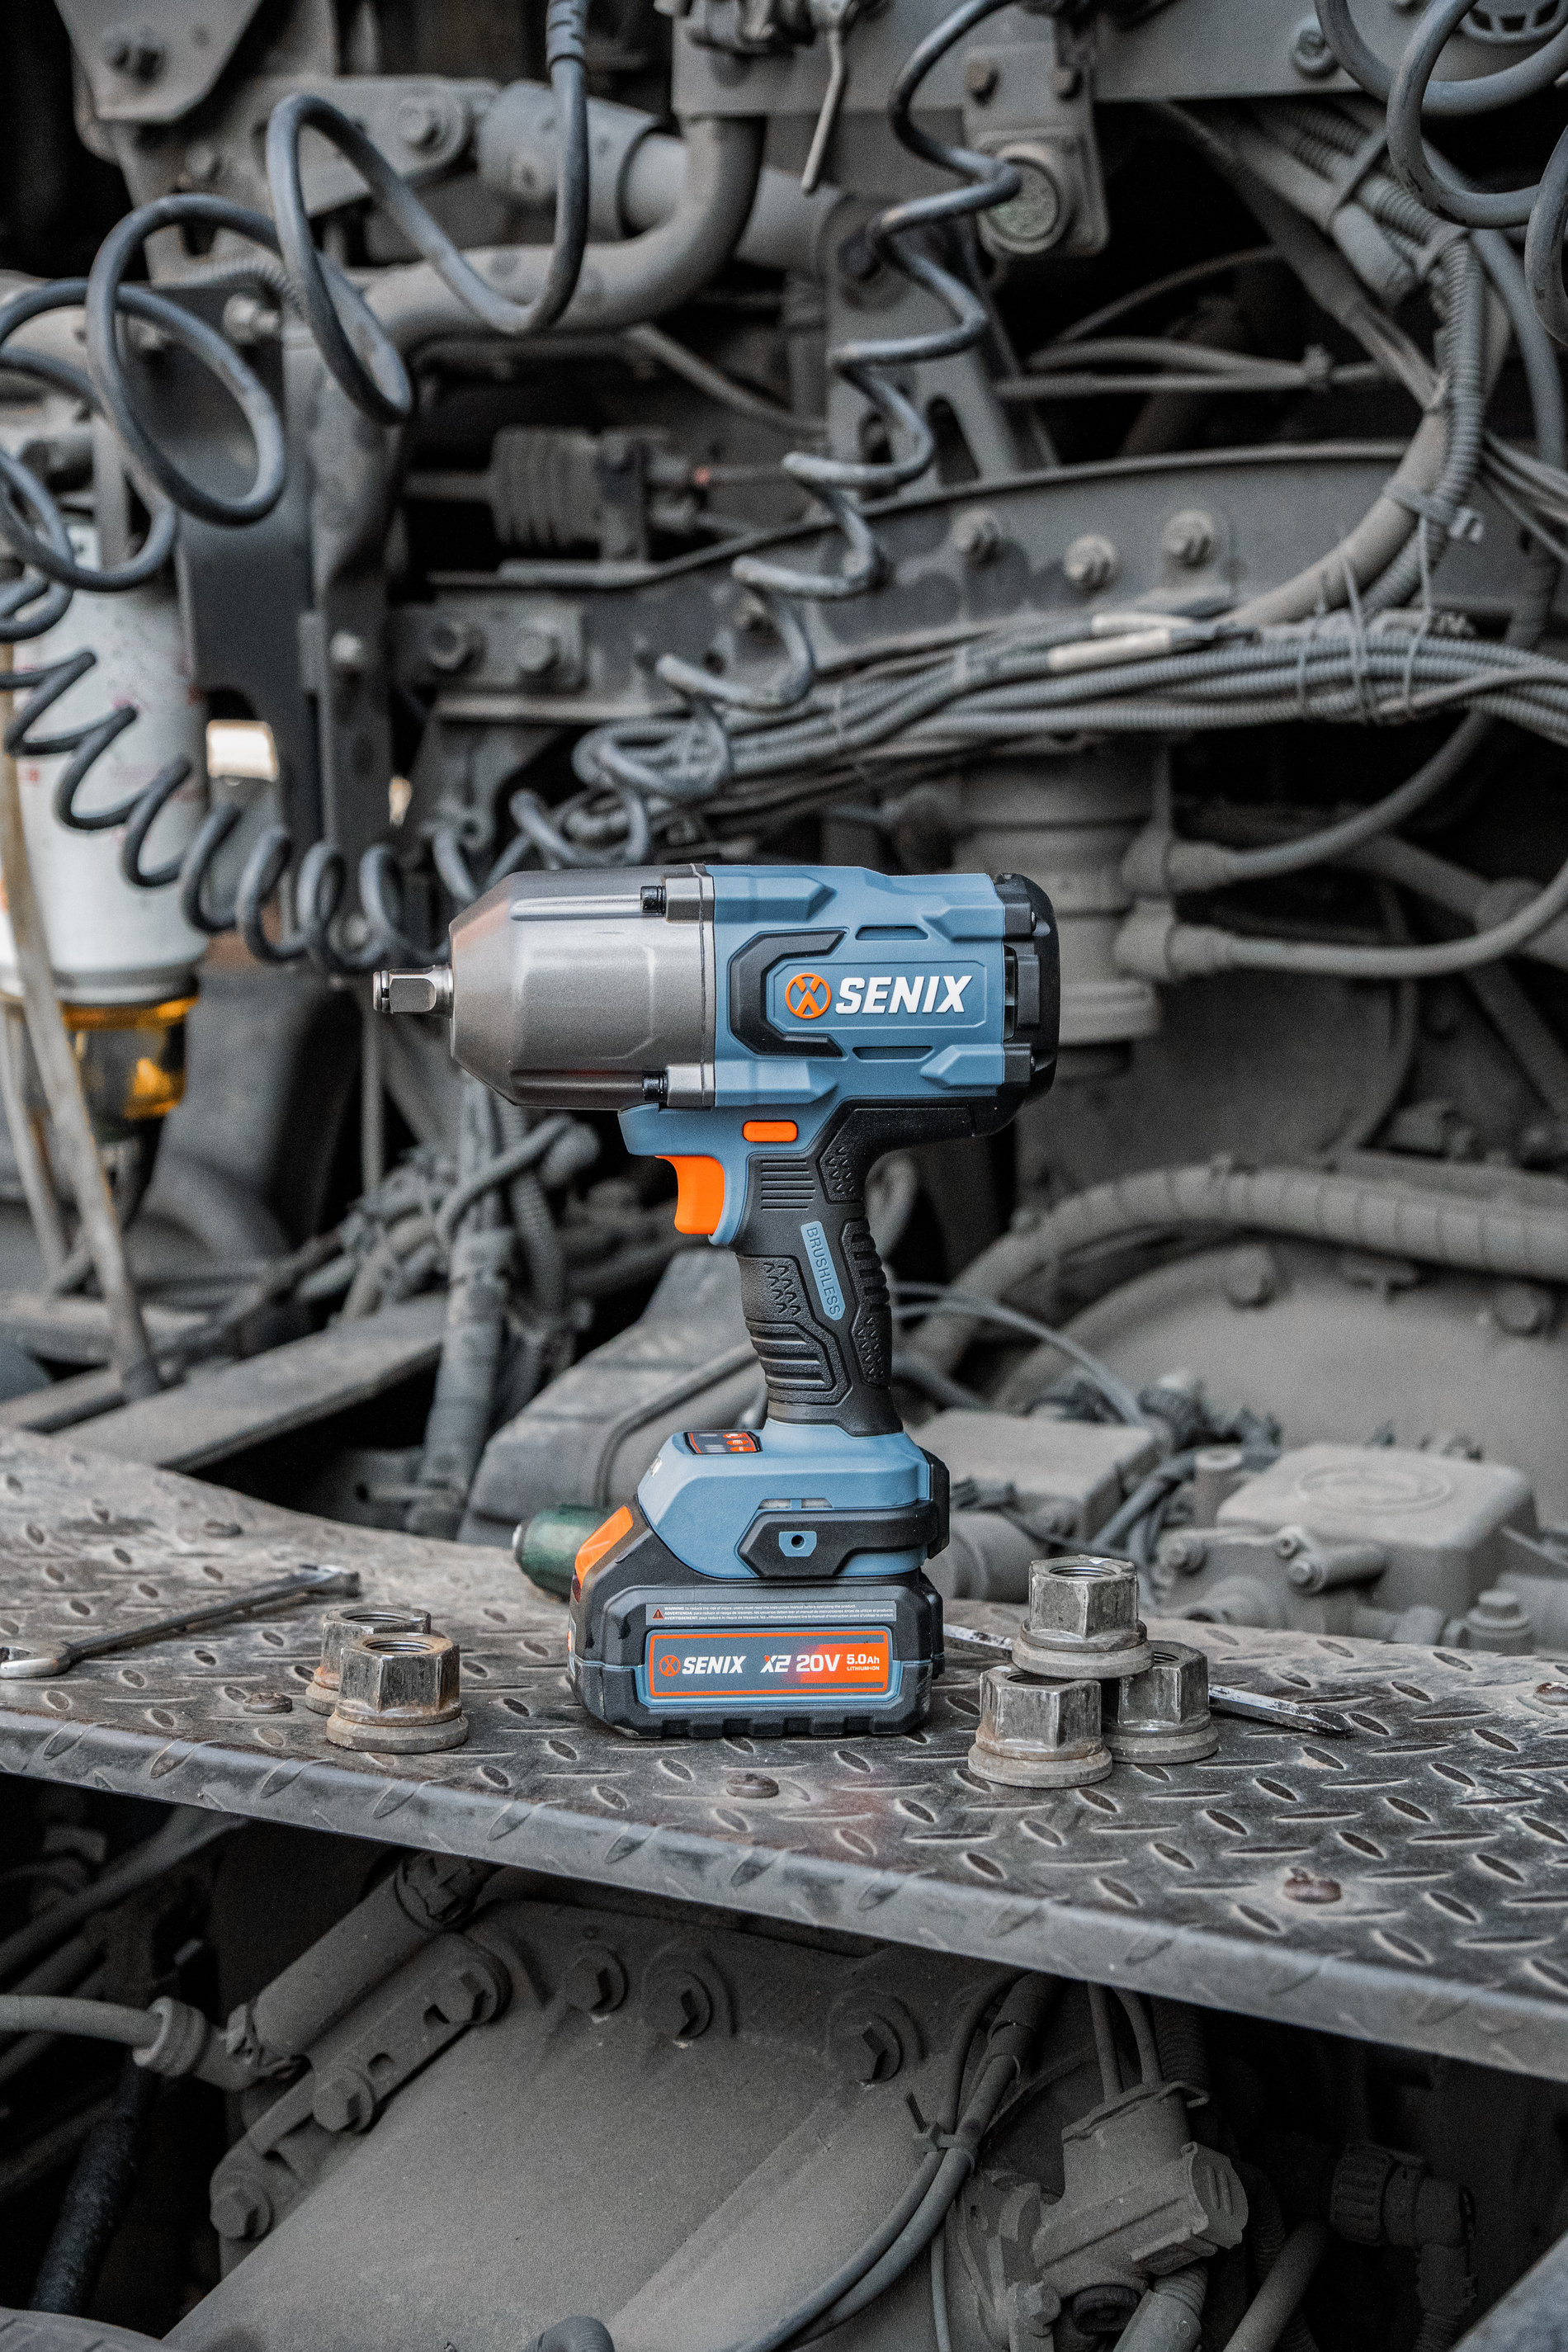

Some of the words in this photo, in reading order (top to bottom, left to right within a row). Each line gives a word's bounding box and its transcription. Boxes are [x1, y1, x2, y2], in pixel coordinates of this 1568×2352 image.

[835, 975, 973, 1014] SENIX
[806, 1226, 841, 1316] BRUSHLESS
[682, 1655, 747, 1674] SENIX
[797, 1654, 840, 1672] 20V
[847, 1654, 880, 1665] 5.0Ah
